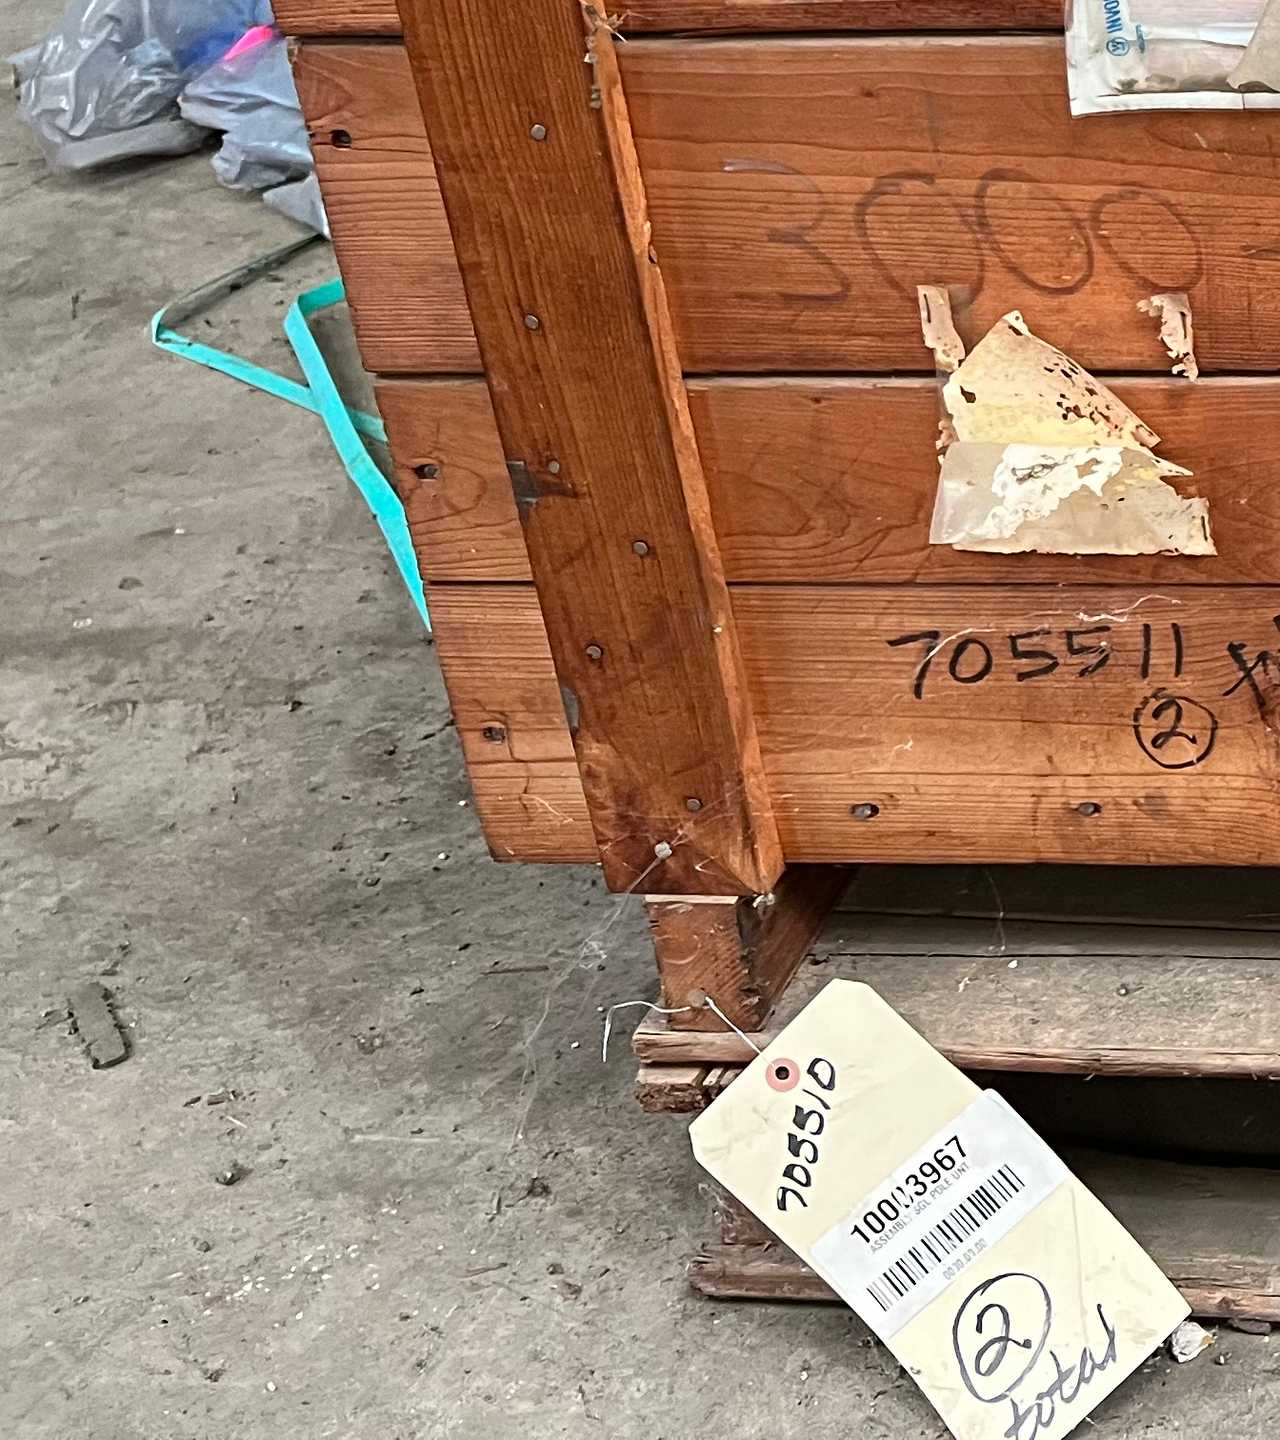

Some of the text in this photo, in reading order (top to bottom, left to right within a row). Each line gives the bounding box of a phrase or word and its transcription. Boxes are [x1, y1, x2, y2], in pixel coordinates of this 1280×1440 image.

[886, 622, 1185, 700] 705511
[776, 1057, 837, 1212] 705510
[1004, 1302, 1117, 1440] total
